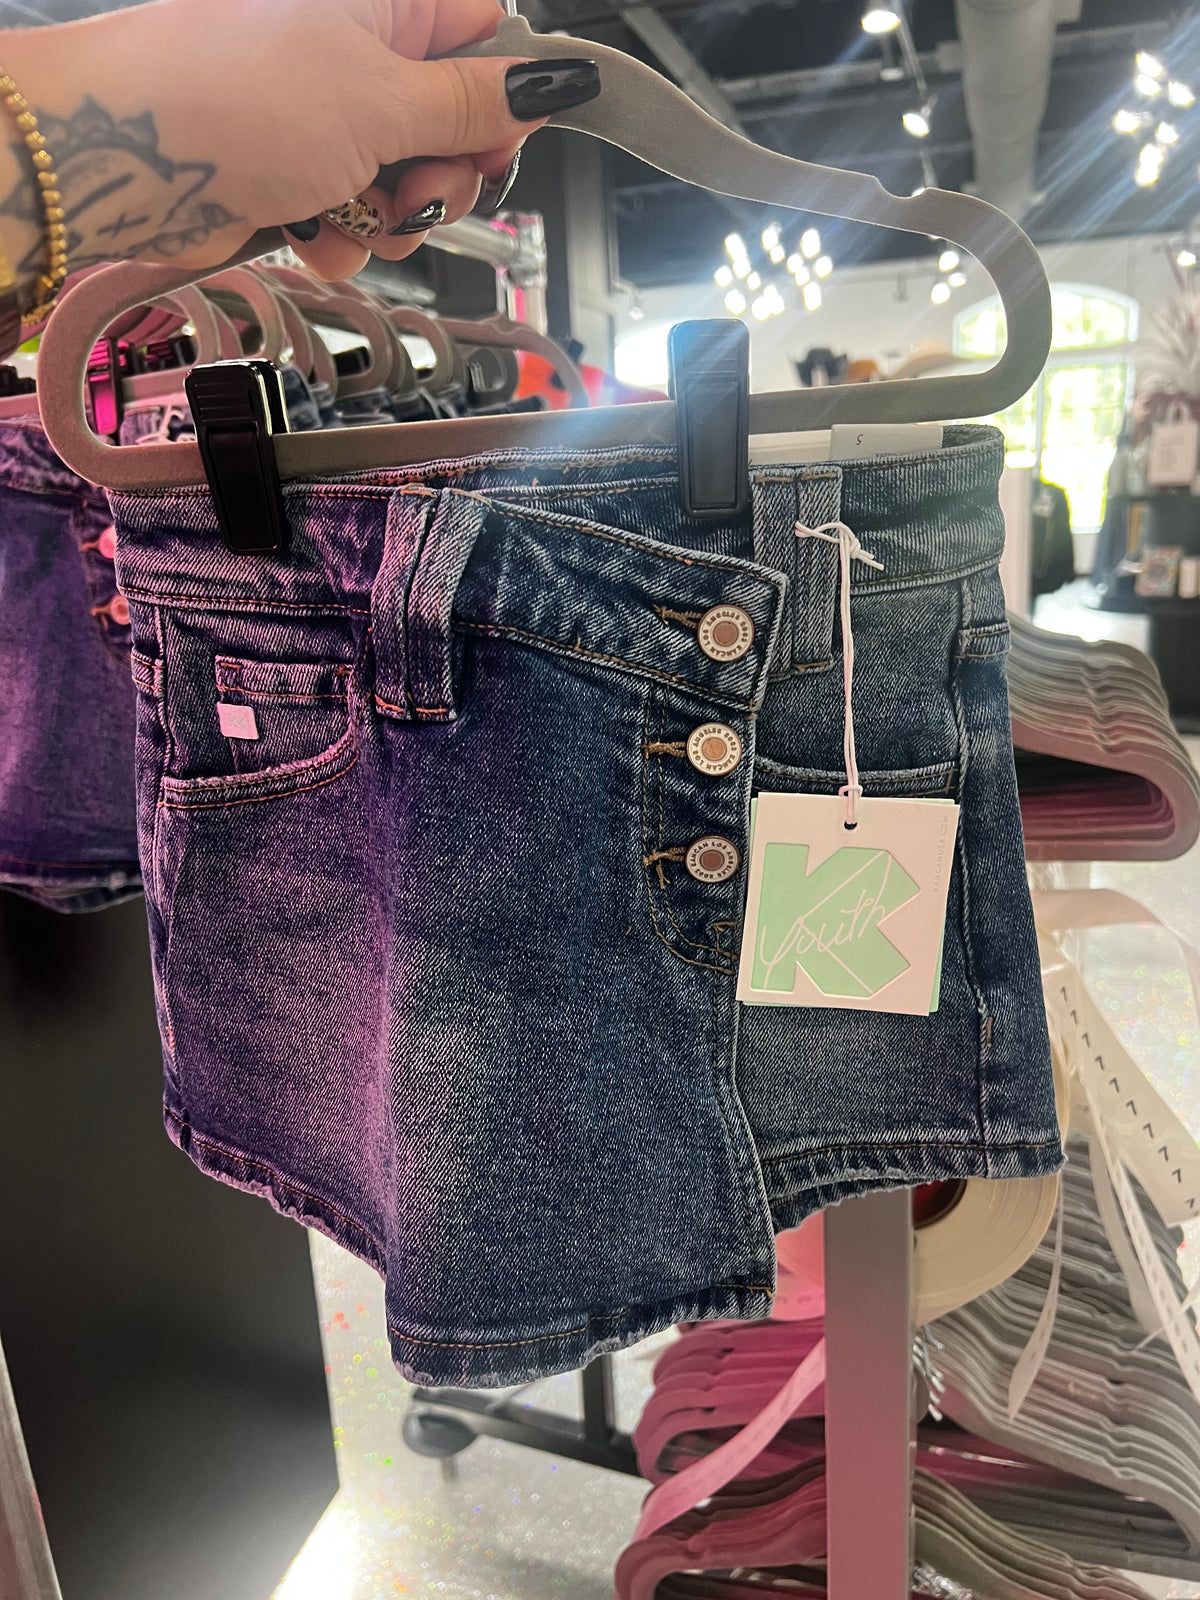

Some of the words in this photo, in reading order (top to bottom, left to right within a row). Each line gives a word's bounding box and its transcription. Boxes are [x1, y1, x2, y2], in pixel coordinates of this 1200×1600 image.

[692, 750, 705, 766] LOS
[705, 754, 736, 771] KANCAN
[690, 842, 709, 867] KANCAN
[711, 841, 728, 850] LOS
